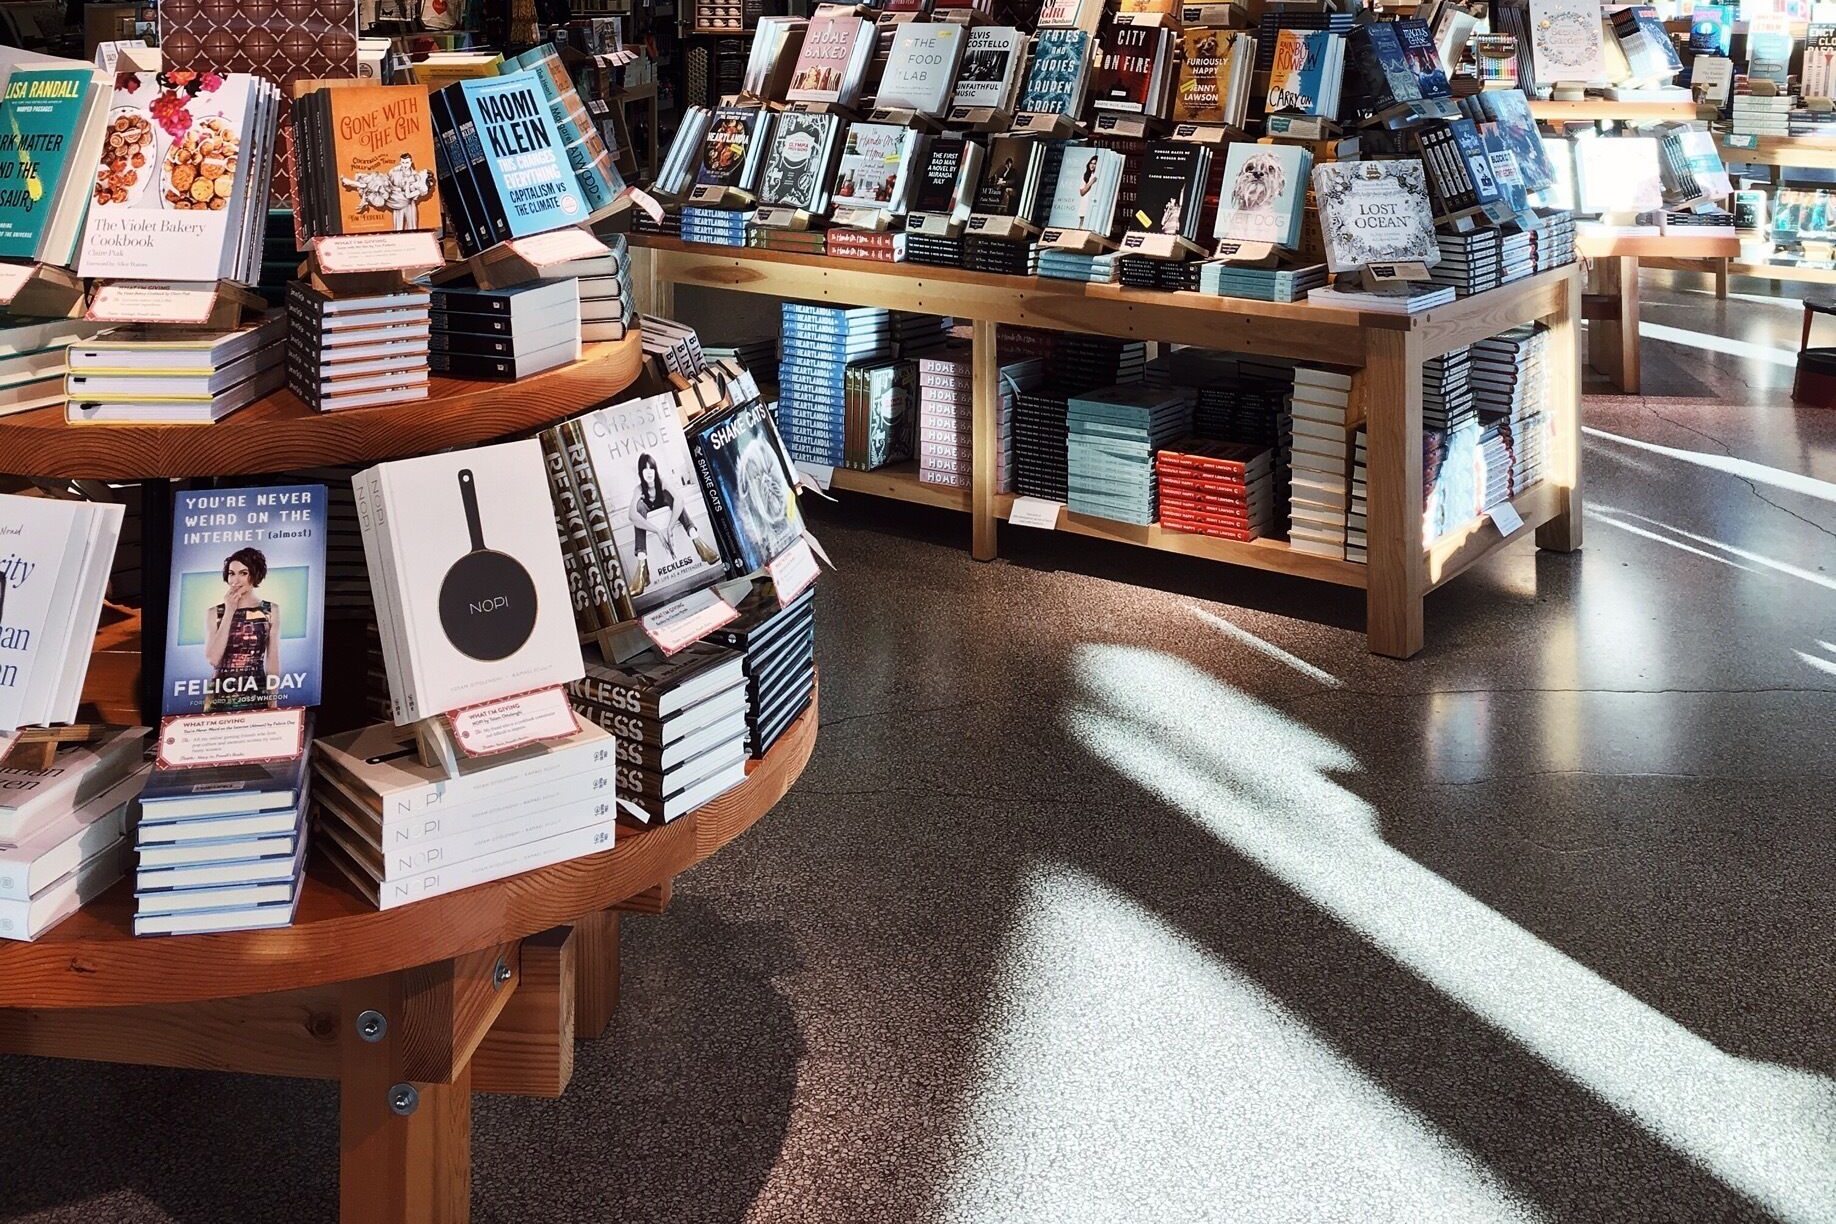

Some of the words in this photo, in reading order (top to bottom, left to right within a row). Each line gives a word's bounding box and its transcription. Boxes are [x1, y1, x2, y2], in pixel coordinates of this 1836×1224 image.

[1041, 8, 1065, 18] GIRL
[810, 31, 850, 45] HOME
[913, 38, 936, 48] THE
[967, 40, 1010, 48] COSTELLO
[969, 31, 991, 40] ELVIS
[1045, 30, 1079, 43] FATES
[1117, 30, 1146, 46] CITY
[804, 46, 848, 60] BAKED
[908, 55, 942, 64] FOOD
[1034, 59, 1075, 73] FURIES
[1104, 55, 1119, 70] ON
[1123, 56, 1150, 74] FIRE
[1186, 58, 1229, 66] FURIOUSLY
[903, 71, 928, 81] LAB
[1192, 67, 1219, 75] HAPPY
[5, 82, 27, 99] LISA
[29, 80, 80, 98] RANDALL
[956, 83, 999, 91] UNFAITHFUL
[1027, 80, 1073, 94] LAUREN
[1190, 84, 1216, 92] JENNY
[1184, 93, 1219, 101] LAWSON
[1269, 86, 1299, 108] CARRY
[1300, 96, 1313, 107] ON
[476, 89, 540, 124] NAOMI
[1027, 101, 1063, 113] GROFF
[340, 109, 381, 141] GONE
[382, 97, 418, 122] WITH
[552, 107, 574, 145] Margaret
[18, 134, 64, 151] MATTER
[359, 129, 393, 153] THE
[395, 116, 420, 141] GIN
[486, 117, 552, 157] KLEIN
[707, 133, 749, 144] HEARTLANDIA
[497, 157, 517, 172] THIS
[518, 150, 557, 168] CHANGES
[0, 162, 14, 179] ND
[17, 162, 41, 179] THE
[503, 166, 561, 189] EVERYTHING
[570, 146, 599, 195] ATWOOD
[0, 190, 34, 212] SAURS
[510, 184, 556, 203] CAPITALISM
[515, 204, 529, 217] THE
[530, 197, 560, 214] CLIMATE
[694, 209, 729, 219] HEARTLANDIA
[1360, 203, 1398, 215] LOST
[94, 218, 118, 232] The
[120, 219, 157, 232] Violet
[160, 220, 207, 237] Bakery
[1222, 213, 1252, 225] WET
[1255, 214, 1285, 227] DOG
[1355, 217, 1410, 228] OCEAN
[90, 234, 154, 248] Cookbook
[796, 305, 831, 316] HEARTLANDIA
[927, 361, 954, 373] HOME
[593, 401, 671, 438] CHRISSIE
[711, 415, 745, 450] SHAKE
[746, 404, 767, 427] CATS
[793, 426, 829, 438] HEARTLANDIA
[608, 428, 670, 460] HYNDE
[697, 458, 714, 486] SHAKE
[709, 485, 723, 513] CATS
[927, 472, 956, 484] HOME
[186, 496, 246, 509] YOU'RE
[257, 492, 311, 506] NEVER
[356, 486, 369, 532] NOPI
[370, 479, 385, 526] NOPI
[185, 514, 237, 527] WEIRD
[247, 512, 268, 524] ON
[280, 510, 311, 522] THE
[567, 443, 628, 600] RECKLESS
[184, 529, 265, 545] INTERNET
[268, 528, 312, 540] (almost)
[547, 452, 608, 607] RECKLESS
[657, 555, 693, 576] RECKLESS
[470, 596, 508, 614] NOPI
[173, 676, 258, 697] FELICIA
[266, 673, 306, 690] DAY
[256, 694, 289, 702] WHEDON
